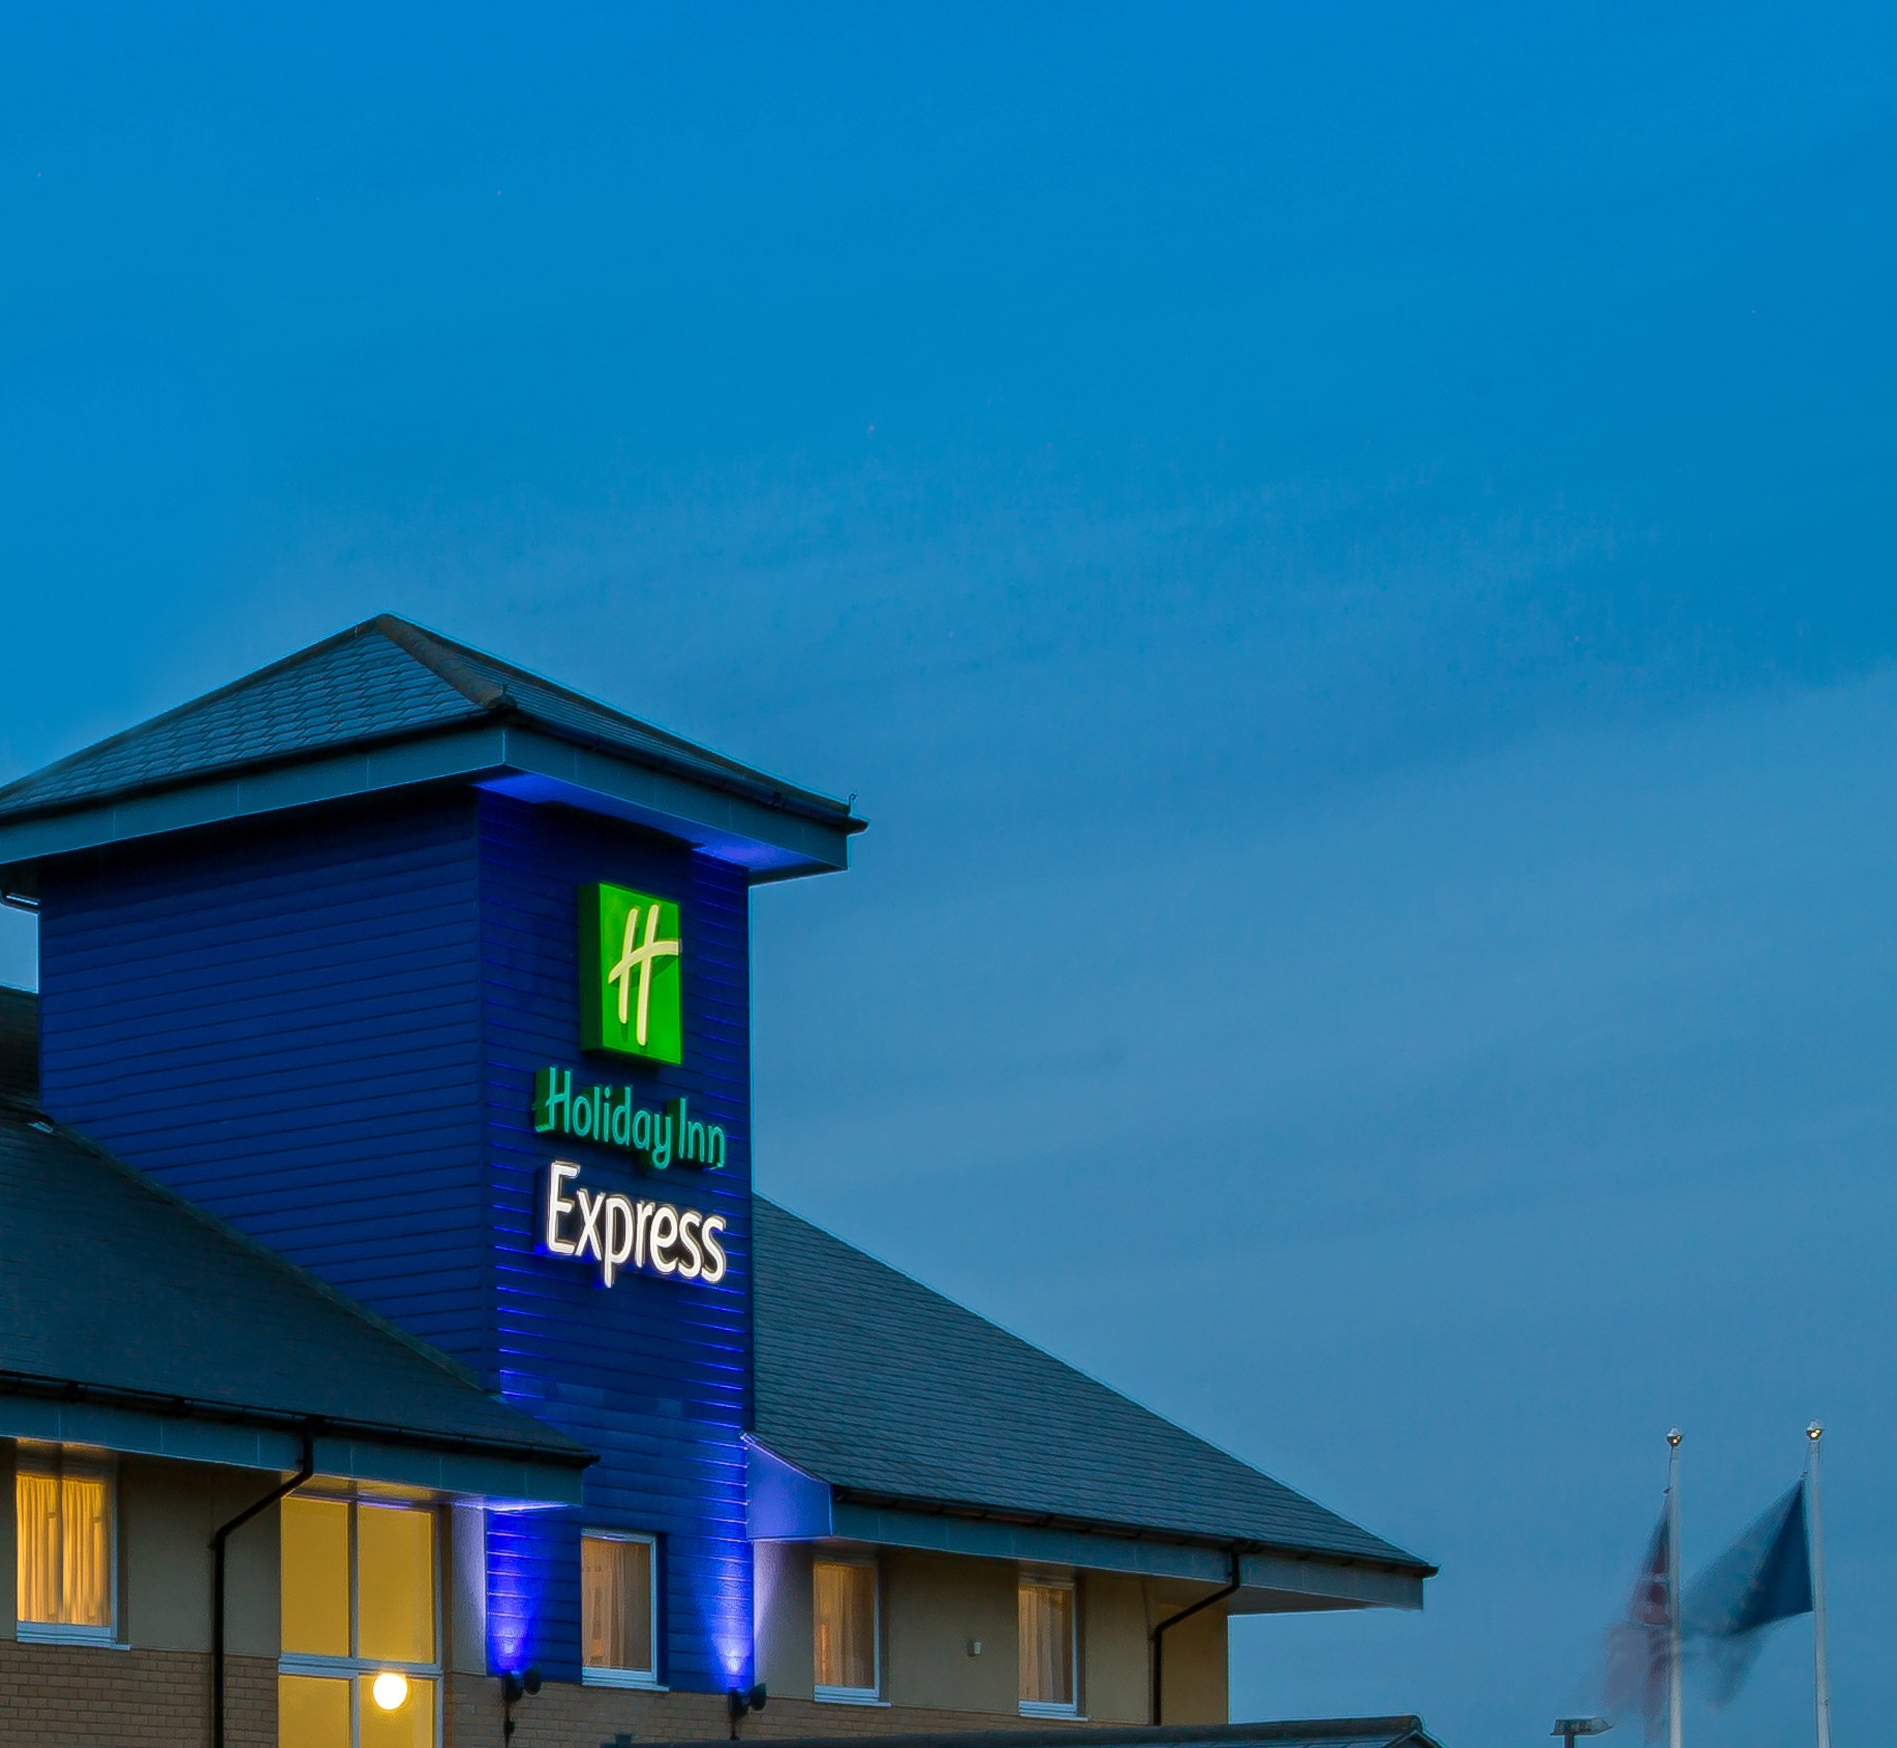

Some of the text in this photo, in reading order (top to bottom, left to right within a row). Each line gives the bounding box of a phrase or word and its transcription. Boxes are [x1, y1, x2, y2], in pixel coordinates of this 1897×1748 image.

[537, 1066, 726, 1169] Holiday Inn
[546, 1160, 727, 1288] Express
